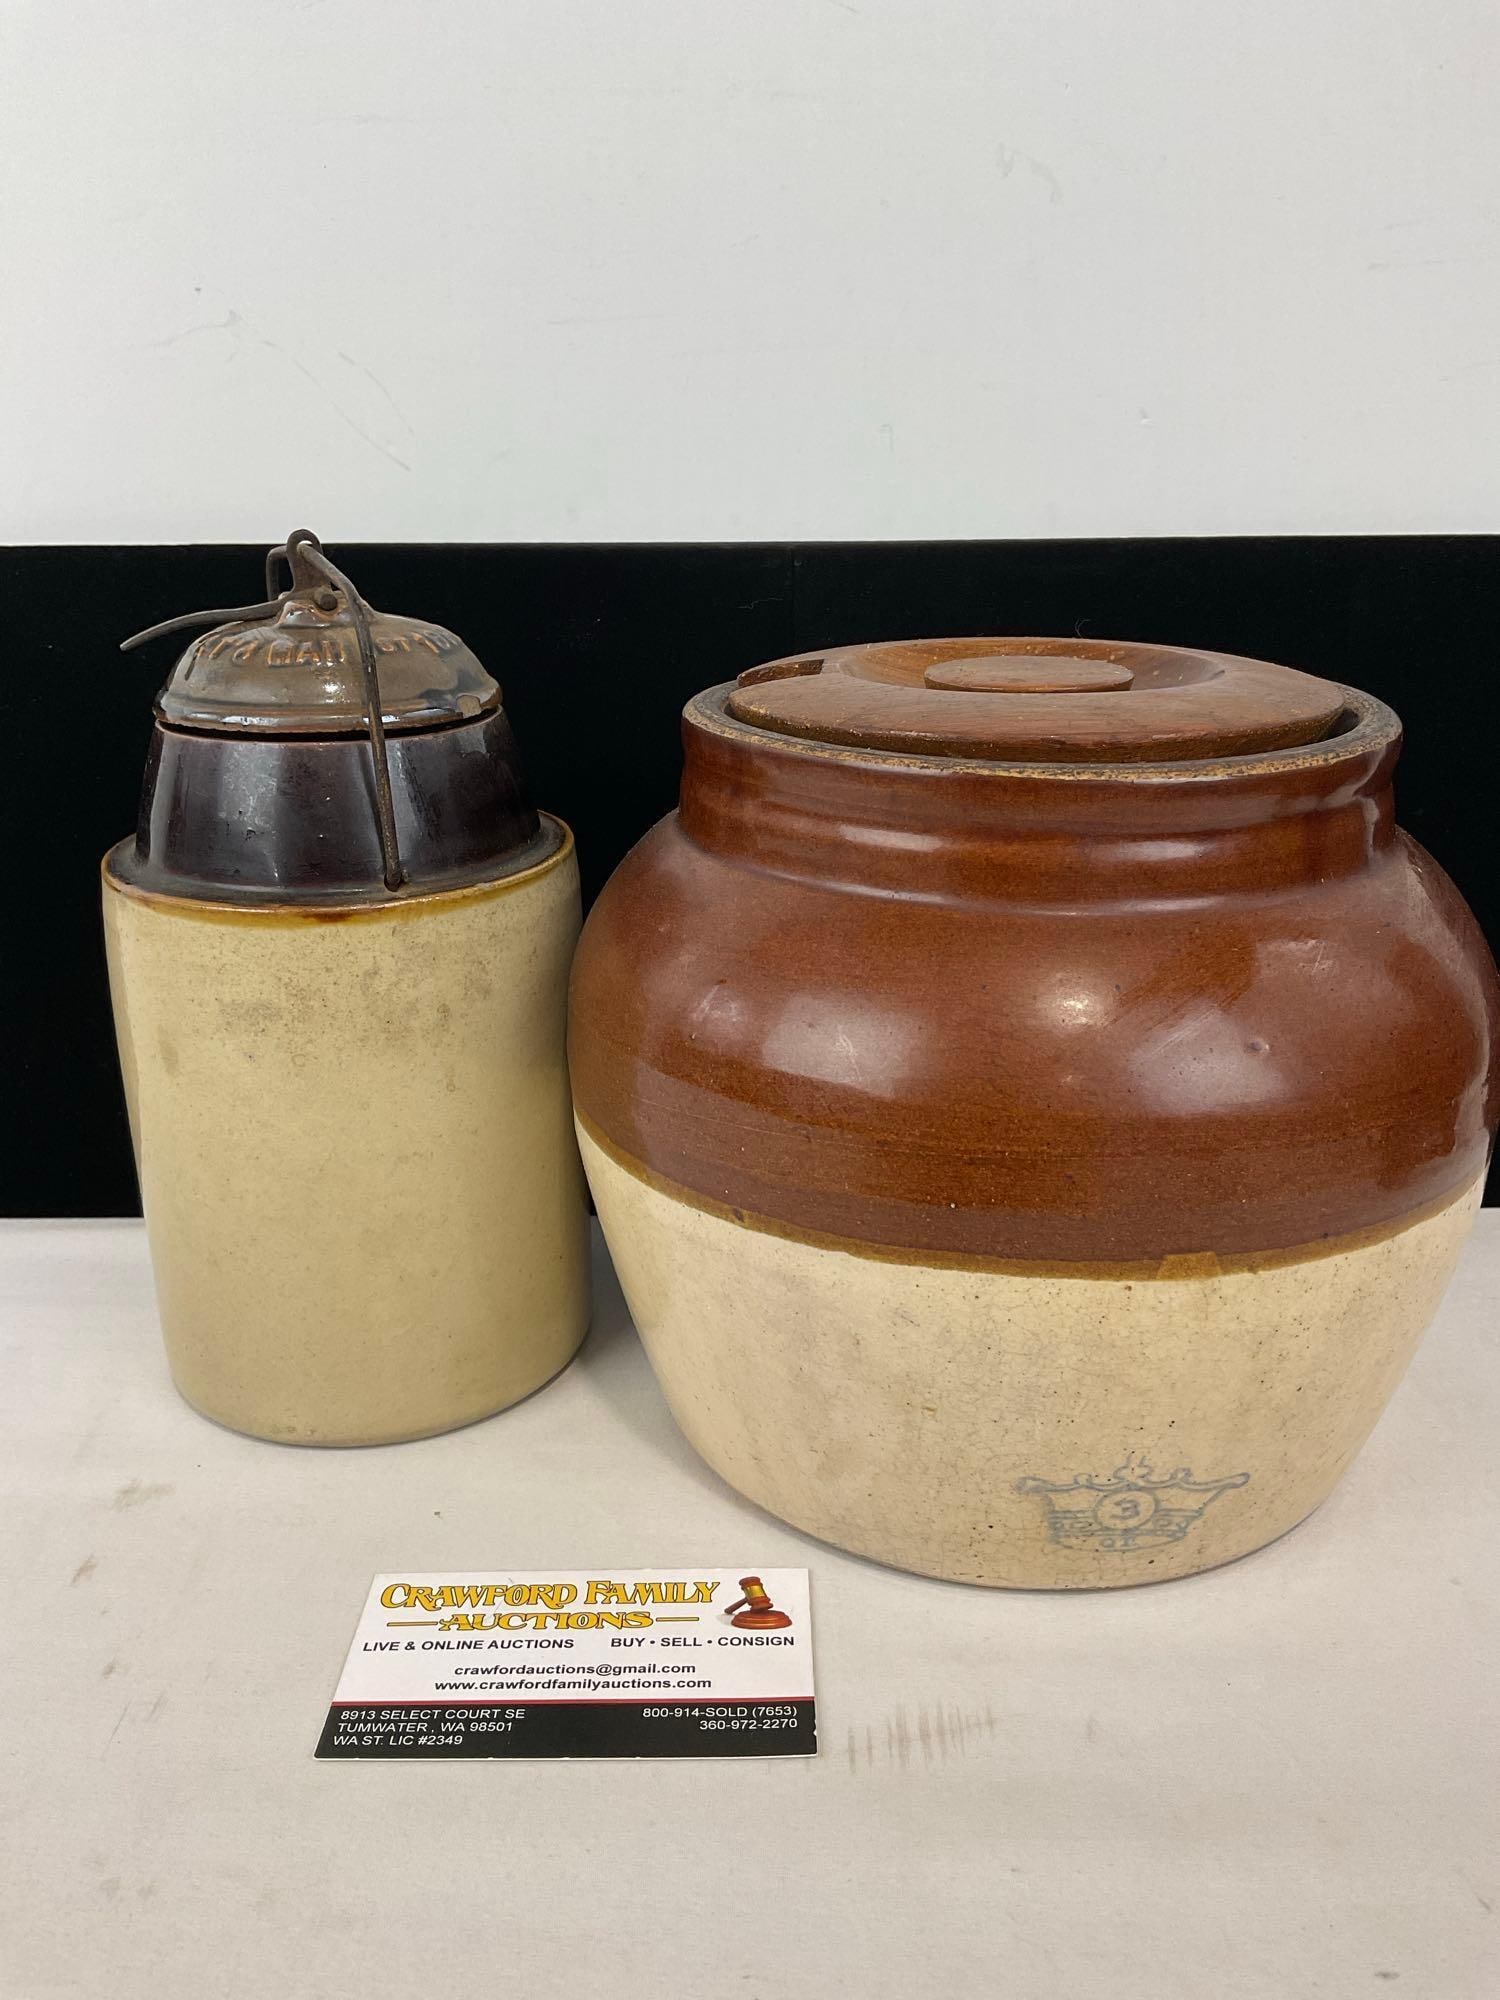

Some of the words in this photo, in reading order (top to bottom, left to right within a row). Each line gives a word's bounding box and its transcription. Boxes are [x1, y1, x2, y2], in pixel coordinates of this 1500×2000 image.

[584, 1580, 721, 1606] FAMILY
[438, 1611, 654, 1631] AUCTIONS
[363, 1641, 400, 1651] LIVE
[404, 1641, 416, 1650] &
[421, 1640, 485, 1650] ONLINE
[487, 1638, 575, 1649] AUCTIONS
[610, 1637, 646, 1648] BUY
[660, 1637, 703, 1647] SELL
[717, 1636, 795, 1647] CONSIGN
[454, 1663, 697, 1676] crawfordauctions@gmail.com
[434, 1678, 713, 1691] www.crawfordfamilyauctions.com
[340, 1710, 376, 1720] 8913
[379, 1710, 441, 1720] SELECT
[444, 1709, 501, 1720] COURT
[504, 1708, 526, 1719] SE
[642, 1707, 748, 1718] 800-914-SOLD
[752, 1706, 798, 1719] (7653)
[338, 1722, 428, 1733] TUMWATER
[440, 1722, 466, 1732] WA
[469, 1722, 513, 1732] 98501
[700, 1718, 798, 1730] 360-972-2270
[333, 1736, 358, 1746] WA
[361, 1736, 383, 1745] ST.
[389, 1735, 415, 1745] LIC
[418, 1735, 463, 1745] #2349
